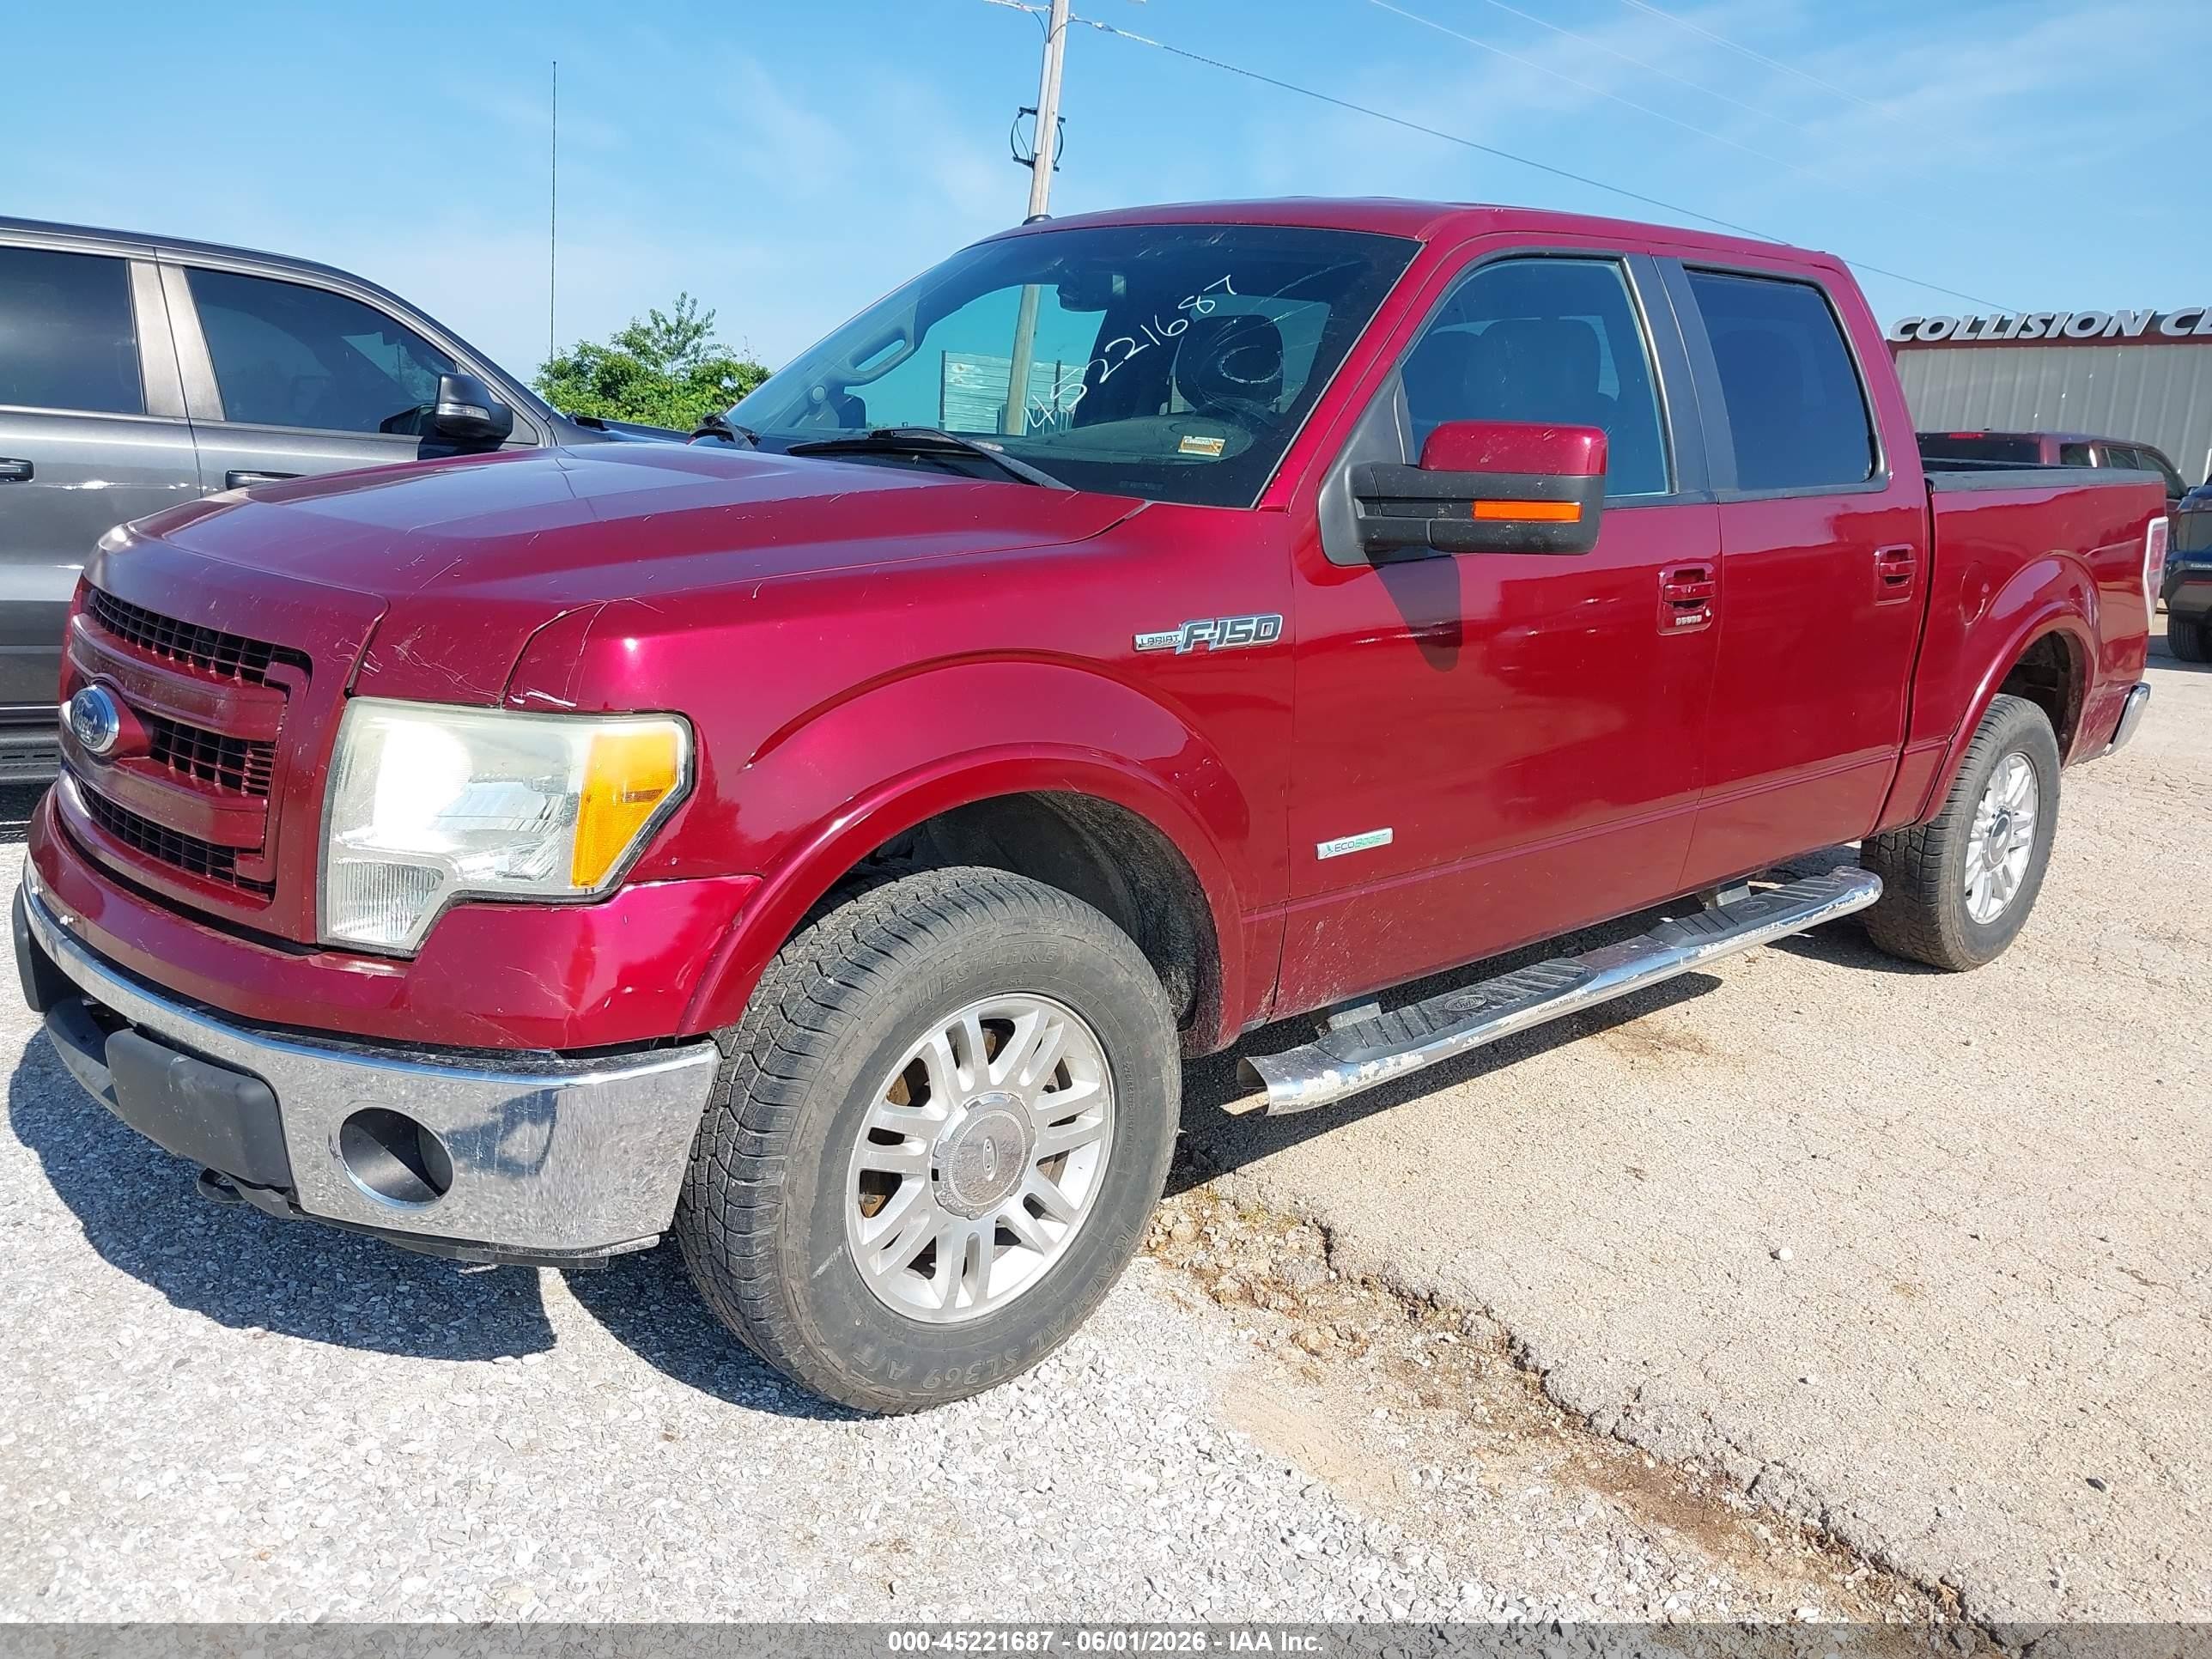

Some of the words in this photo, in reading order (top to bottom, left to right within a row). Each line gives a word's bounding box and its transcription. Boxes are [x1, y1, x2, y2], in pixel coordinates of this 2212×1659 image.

[1889, 309, 2154, 342] COLLISION
[1024, 274, 1237, 428] 45221687
[1139, 634, 1180, 647] LARIAT
[1176, 613, 1283, 655] F-150
[907, 943, 1059, 1017] WESTLAKE
[921, 1345, 1020, 1389] SL369
